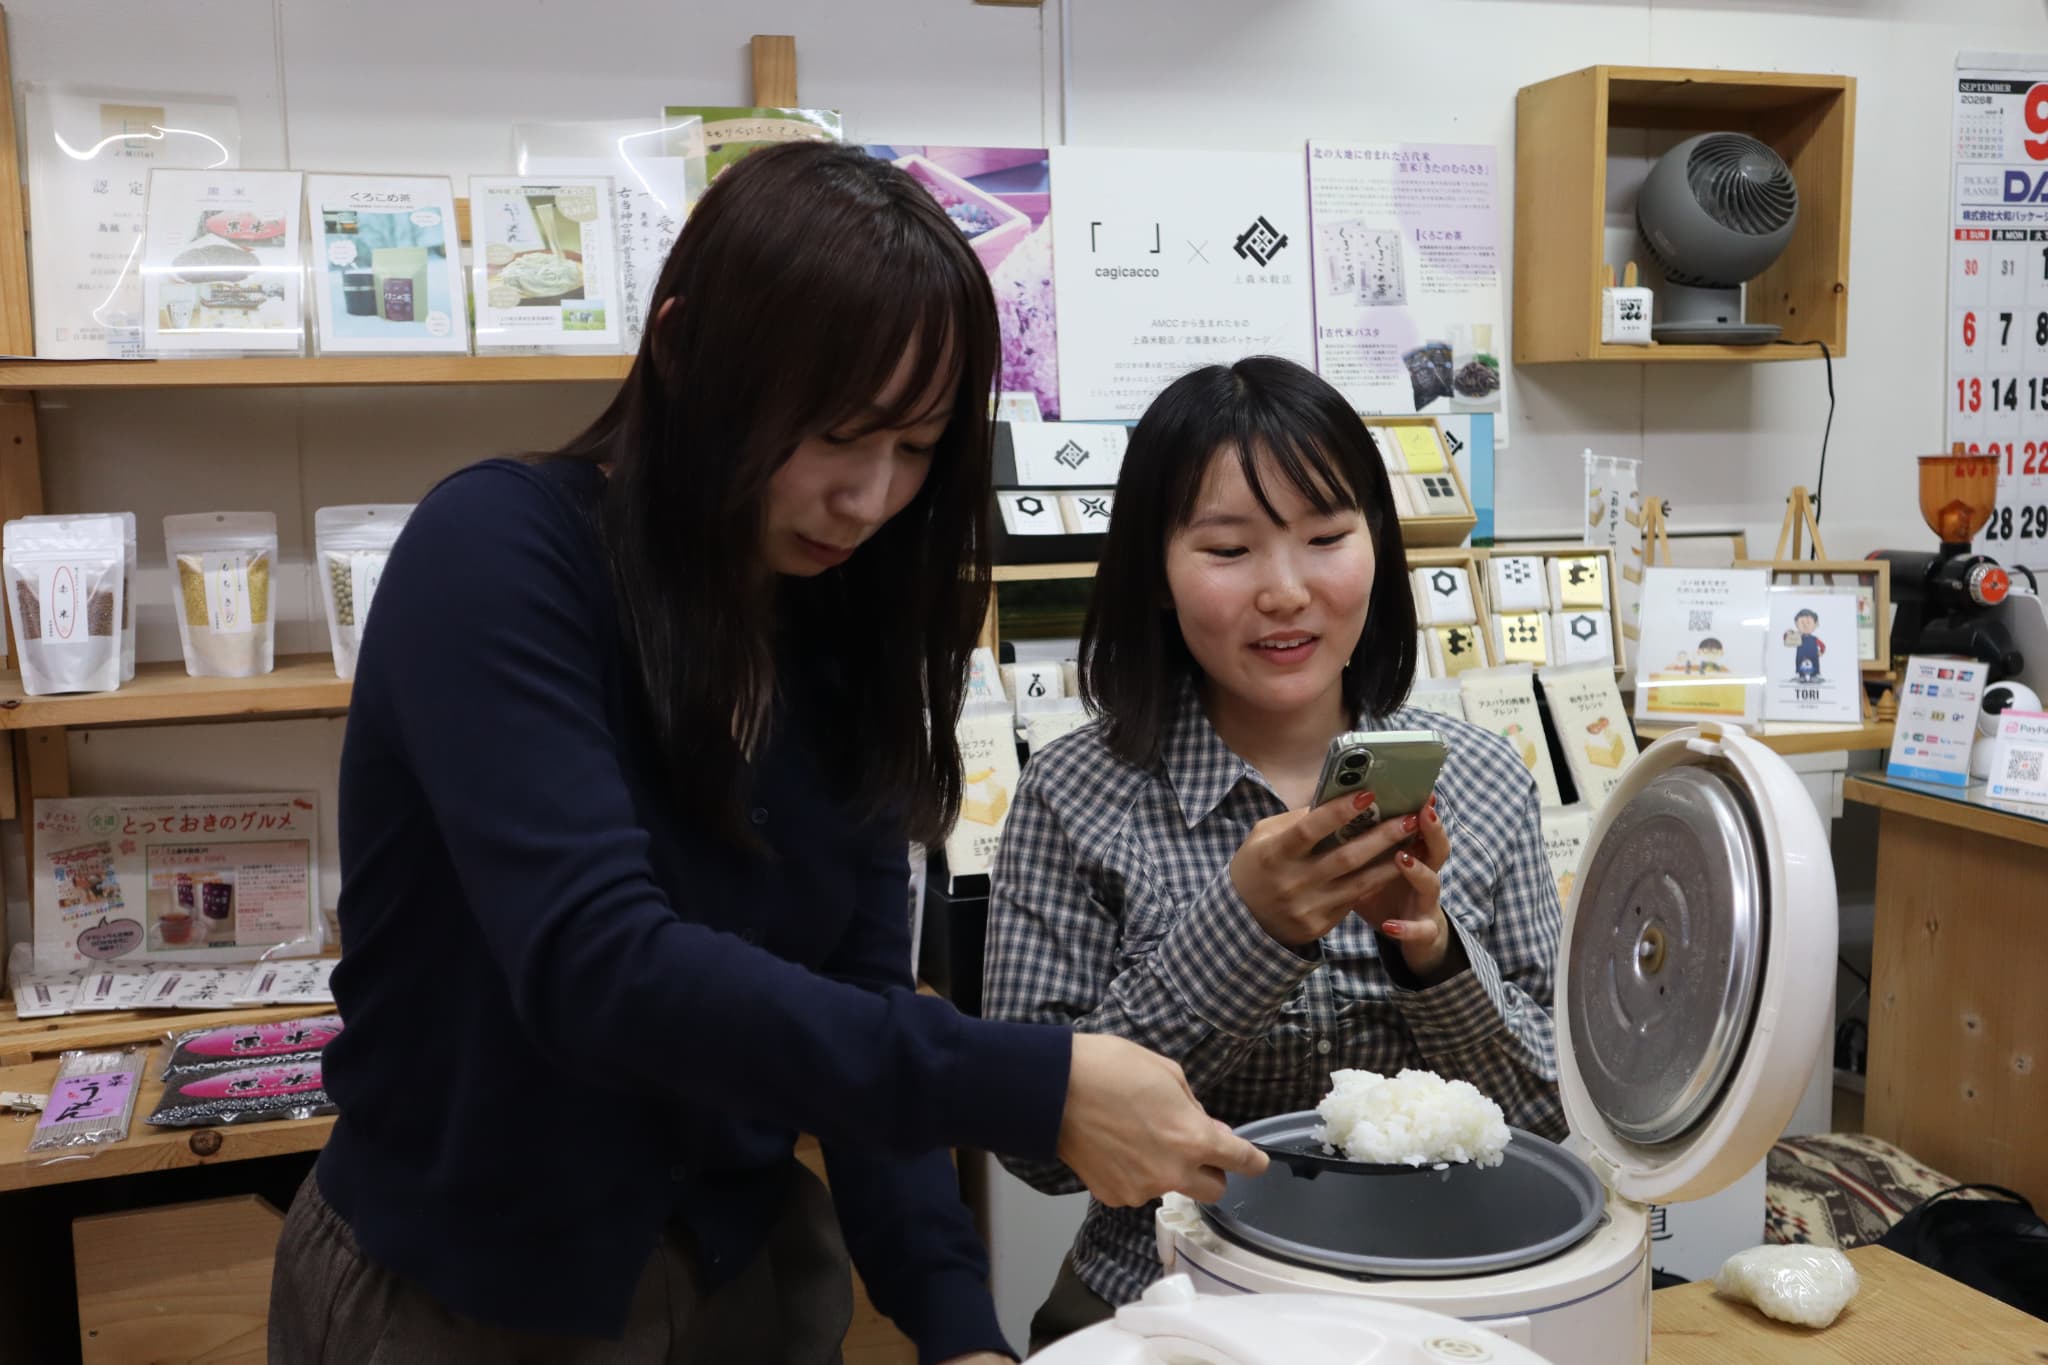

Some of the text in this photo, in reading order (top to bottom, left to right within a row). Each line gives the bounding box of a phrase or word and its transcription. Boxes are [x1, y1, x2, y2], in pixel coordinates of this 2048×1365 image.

[1960, 83, 2012, 93] SEPTEMBER
[1960, 96, 1993, 104] 2026年
[1313, 148, 1431, 162] 北の大地に育まれた古代米
[1963, 176, 2000, 186] PACKAGE
[349, 191, 411, 204] くろこめ茶
[1963, 186, 1999, 197] PLANNER
[1421, 230, 1463, 241] くろこめ茶
[2005, 230, 2025, 240] MON
[1095, 265, 1160, 280] cagicacco
[1964, 259, 1979, 275] 30
[2001, 259, 2015, 275] 31
[1324, 327, 1380, 338] 古代米パスタ
[1963, 312, 1976, 347] 6
[2000, 312, 2013, 346] 7
[2035, 311, 2048, 346] 8
[1957, 378, 1982, 412] 13
[1992, 378, 2018, 412] 14
[2023, 441, 2048, 475] 22
[1985, 507, 2013, 541] 28
[2020, 505, 2048, 539] 29
[1795, 688, 1820, 701] TORI
[121, 812, 292, 835] とっておきのグルメ
